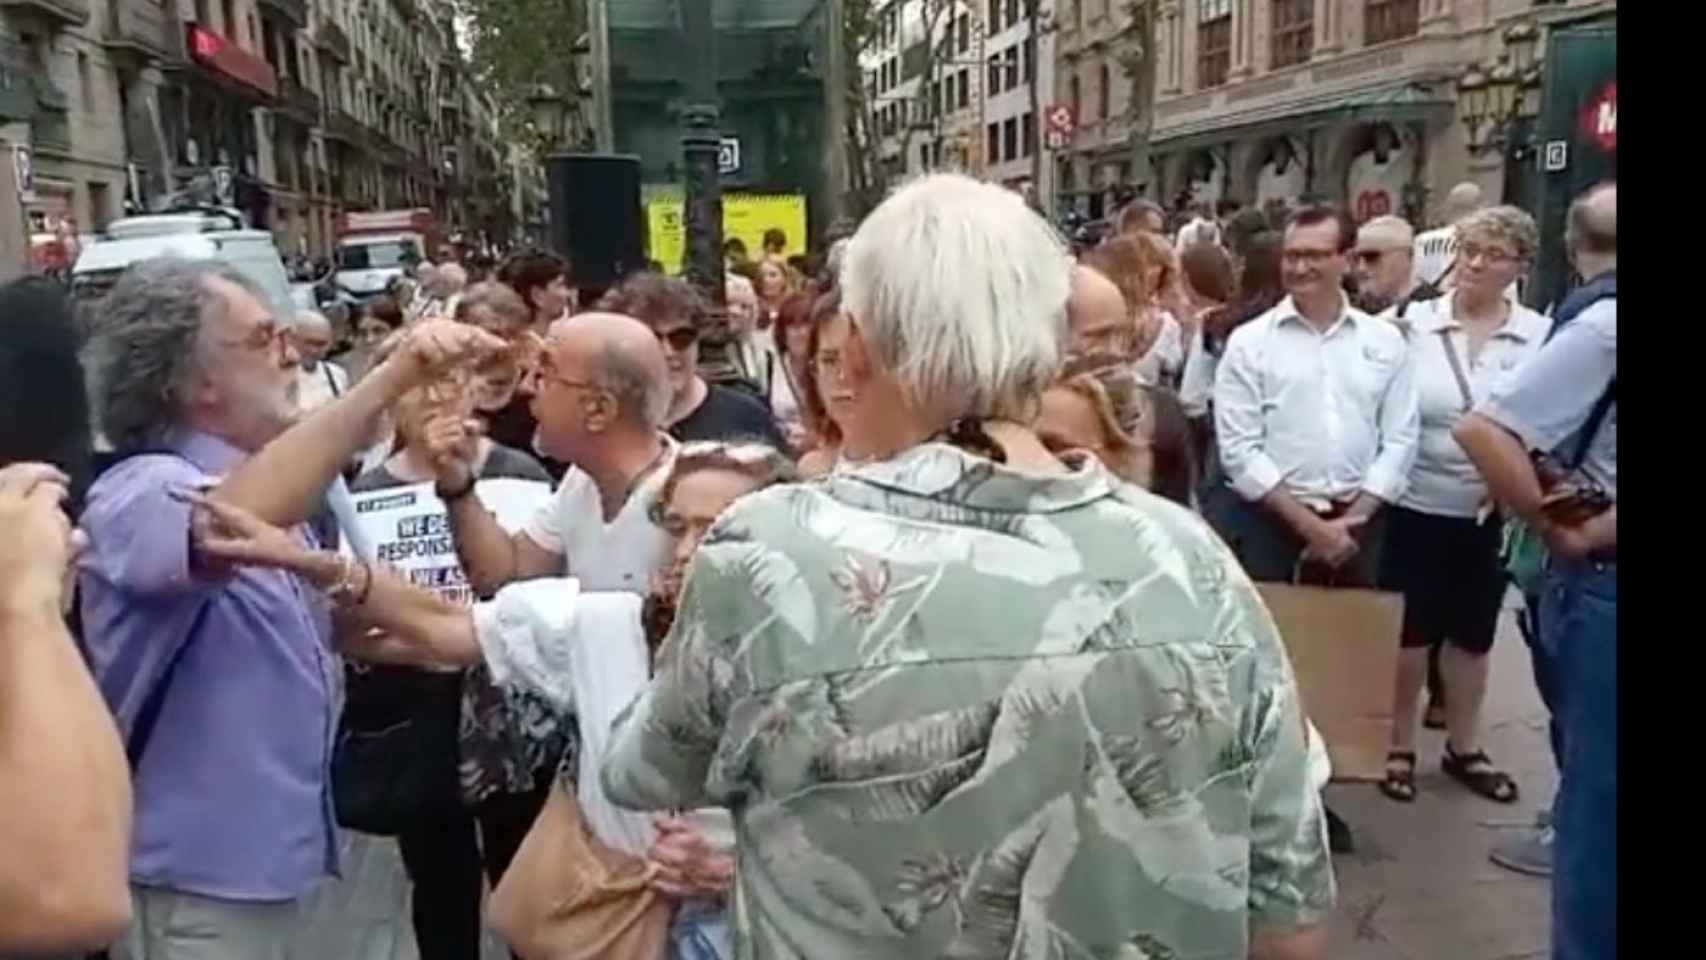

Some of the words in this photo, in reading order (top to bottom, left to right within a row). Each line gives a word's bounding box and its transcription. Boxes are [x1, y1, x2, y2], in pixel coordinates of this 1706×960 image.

[400, 516, 424, 537] WE
[428, 514, 450, 535] DE
[413, 569, 438, 587] WE
[445, 567, 464, 586] AS
